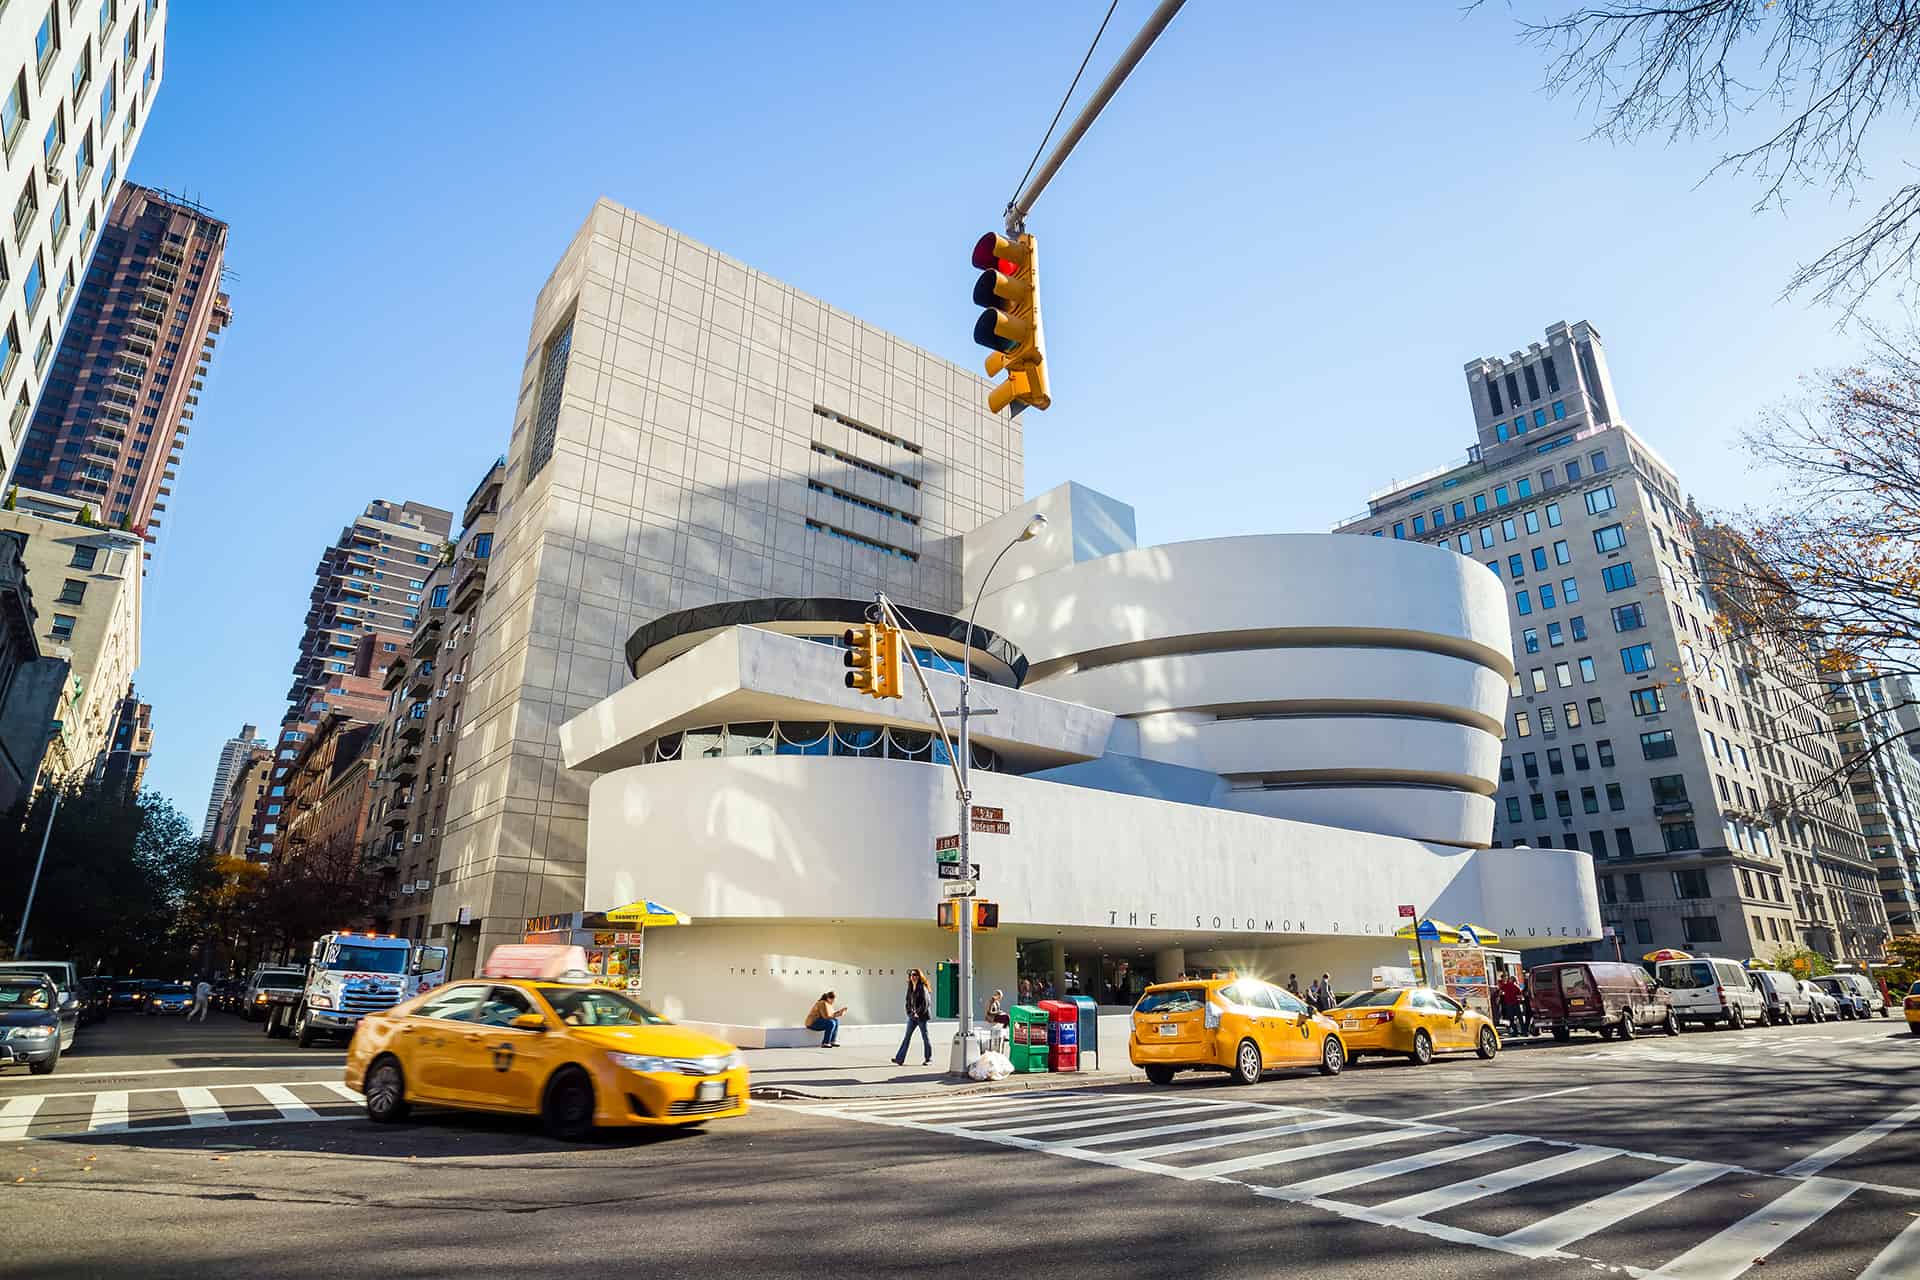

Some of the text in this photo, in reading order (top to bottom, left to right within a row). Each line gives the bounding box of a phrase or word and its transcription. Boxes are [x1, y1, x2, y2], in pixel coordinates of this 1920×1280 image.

[1109, 911, 1157, 927] THE
[1196, 915, 1306, 932] SOLOMON
[1504, 927, 1592, 937] MUSEUM
[730, 967, 757, 976] THE
[770, 968, 895, 977] THANNHAUSER
